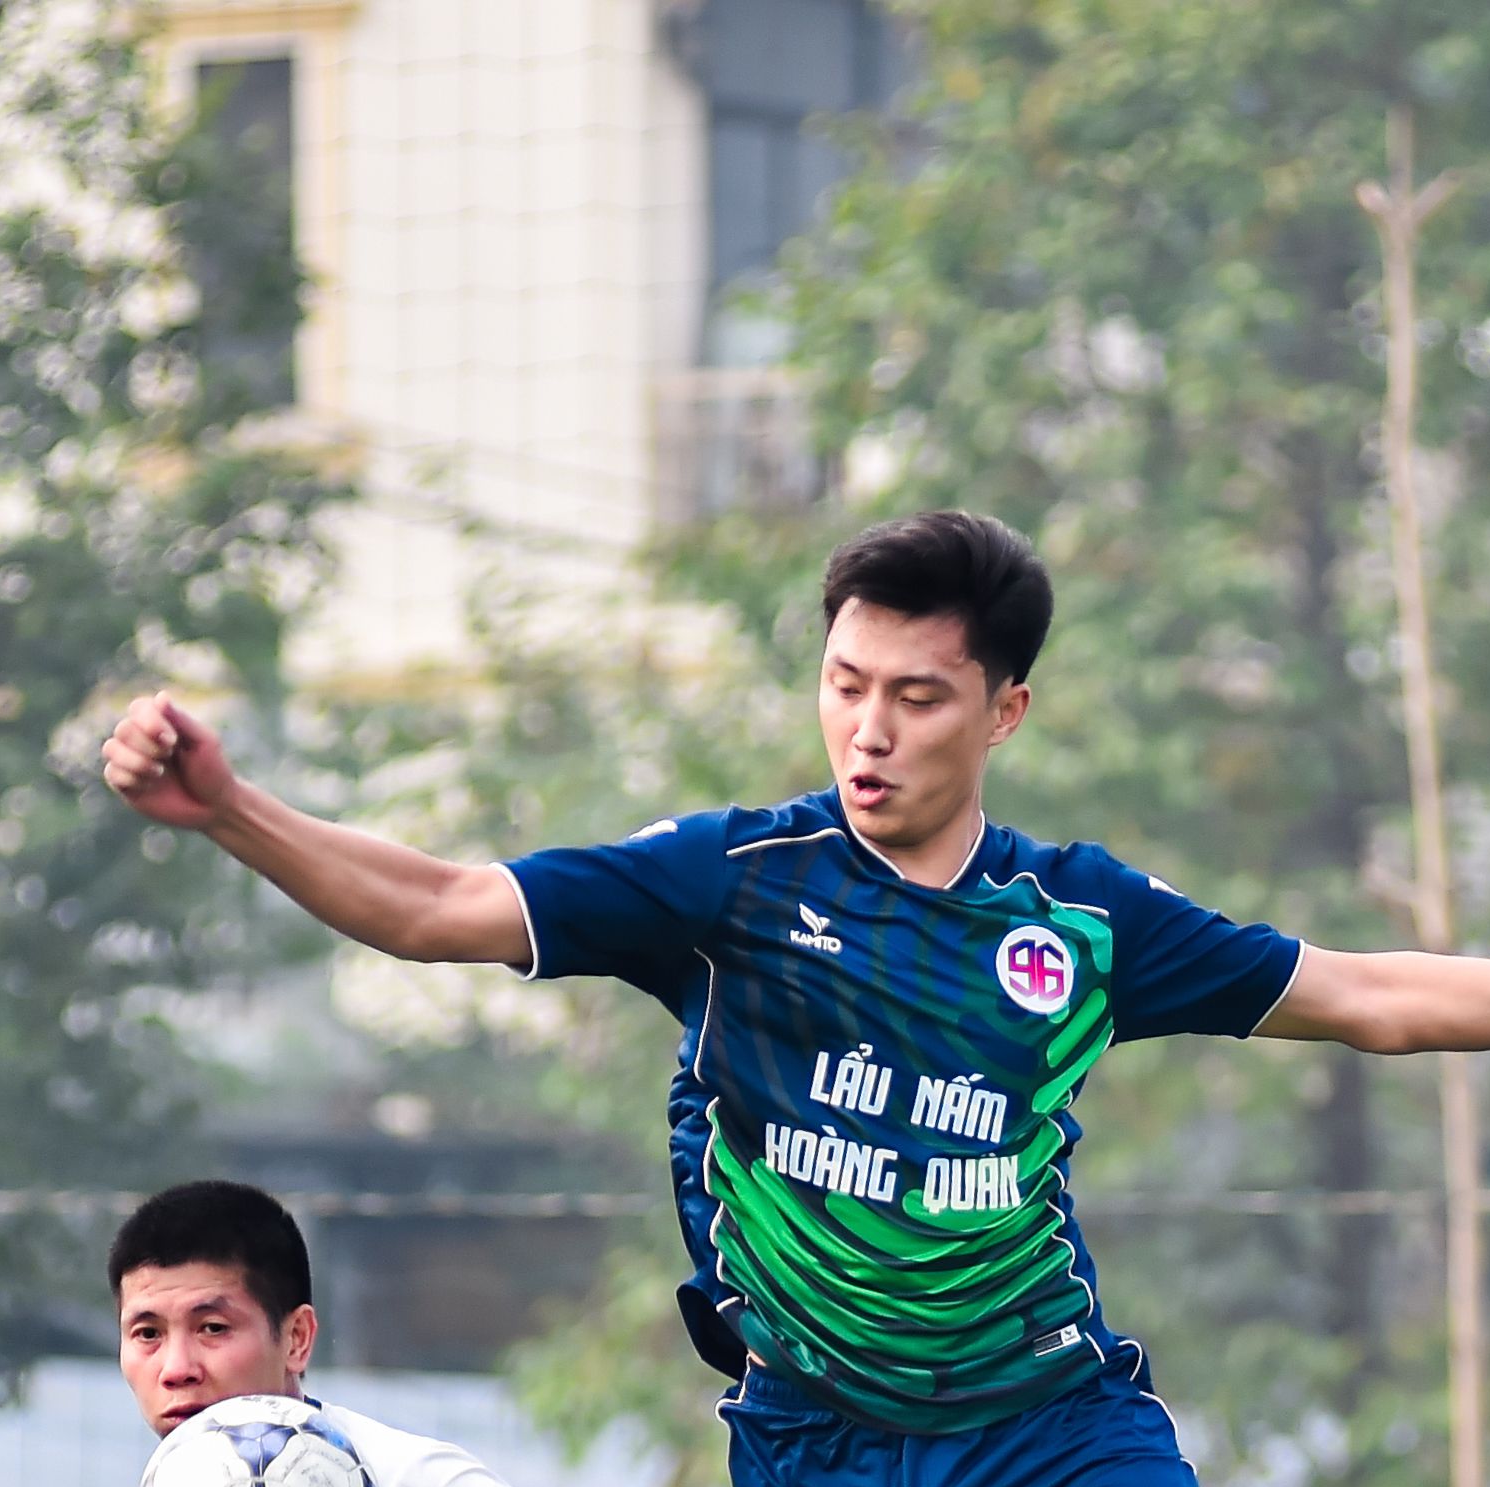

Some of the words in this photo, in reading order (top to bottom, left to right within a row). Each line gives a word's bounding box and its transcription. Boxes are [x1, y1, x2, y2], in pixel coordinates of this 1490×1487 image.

[790, 929, 842, 955] KAMITO
[1008, 938, 1065, 1002] 96
[809, 1042, 893, 1116] LẨU
[910, 1072, 1008, 1145] NẤM
[765, 1122, 899, 1203] HOÀNG
